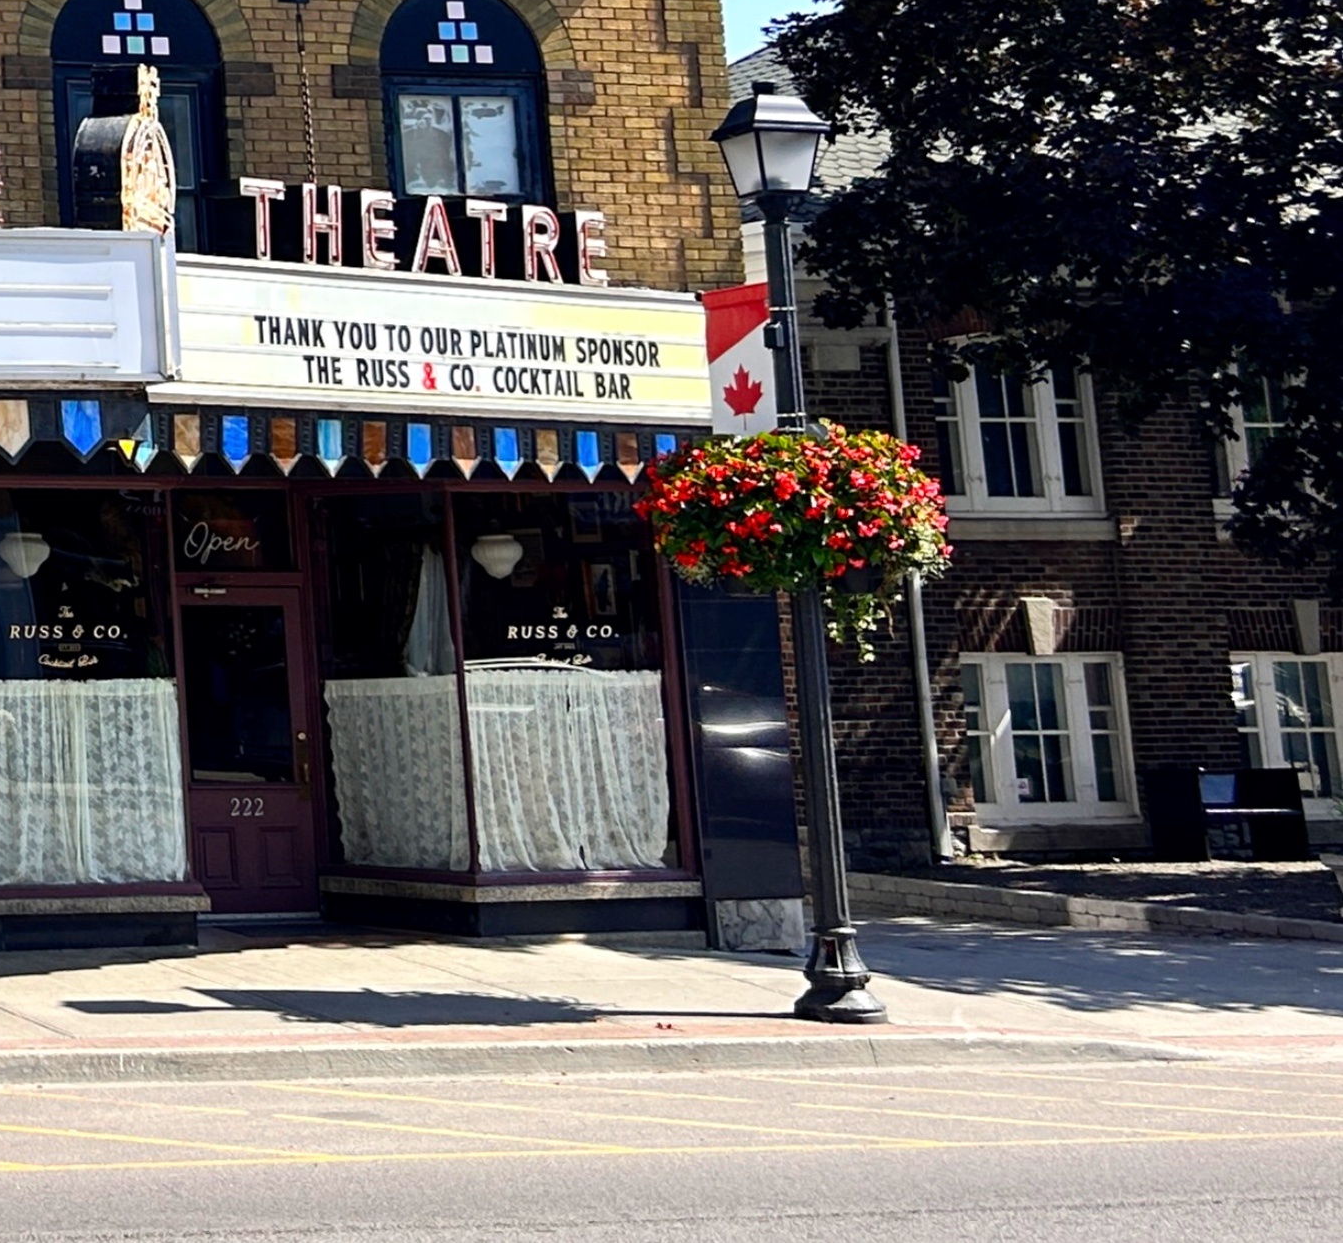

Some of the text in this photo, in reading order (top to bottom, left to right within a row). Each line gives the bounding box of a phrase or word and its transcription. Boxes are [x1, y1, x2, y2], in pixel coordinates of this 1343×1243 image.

[239, 176, 612, 288] THEATRE
[253, 314, 662, 368] THANK YOU TO OUR PLATINUM SPONSOR
[302, 354, 633, 401] THE RUSS & CO. COCKTAIL BAR
[184, 521, 260, 565] Open
[9, 624, 128, 639] RUSS & CO.
[507, 624, 620, 639] RUSS & CO.
[230, 797, 264, 817] 222
